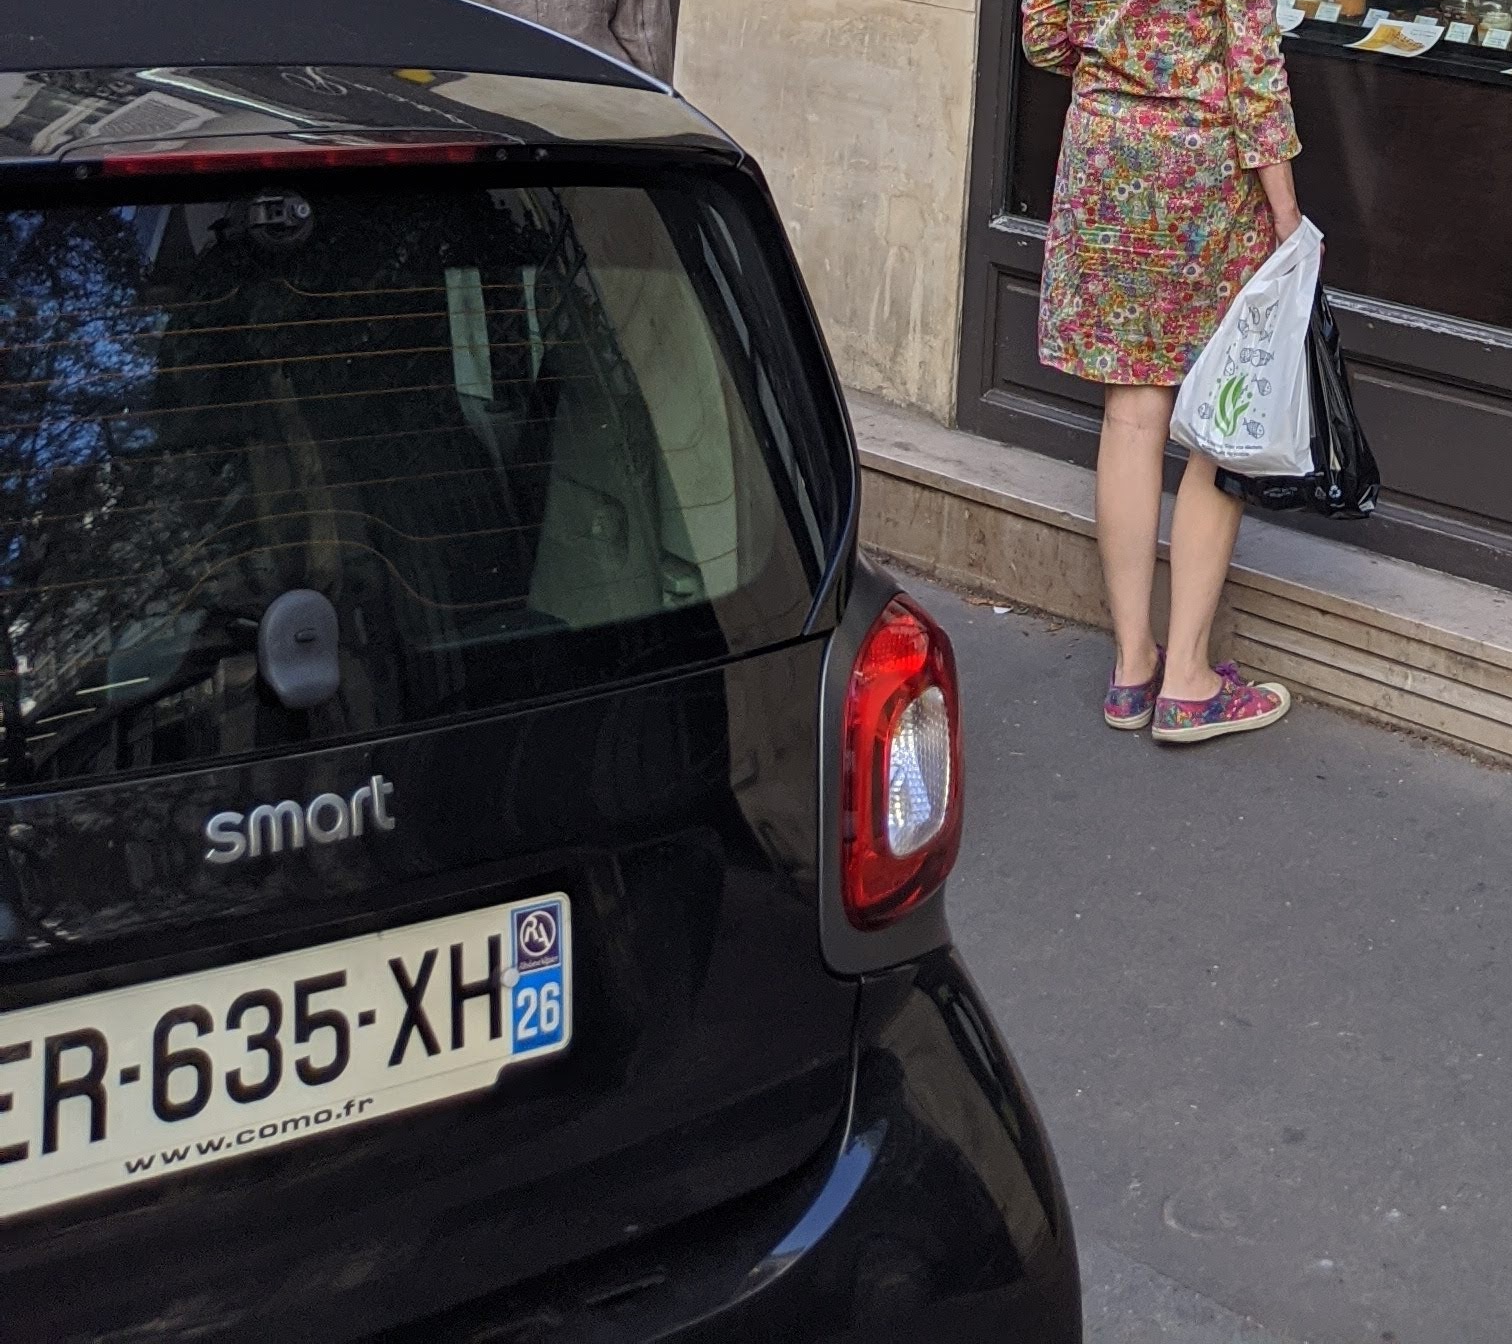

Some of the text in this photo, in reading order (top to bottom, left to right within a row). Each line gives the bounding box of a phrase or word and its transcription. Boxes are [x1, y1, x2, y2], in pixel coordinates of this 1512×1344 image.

[205, 774, 396, 865] smart
[516, 981, 561, 1042] 26
[124, 1094, 375, 1176] www.como.fr
